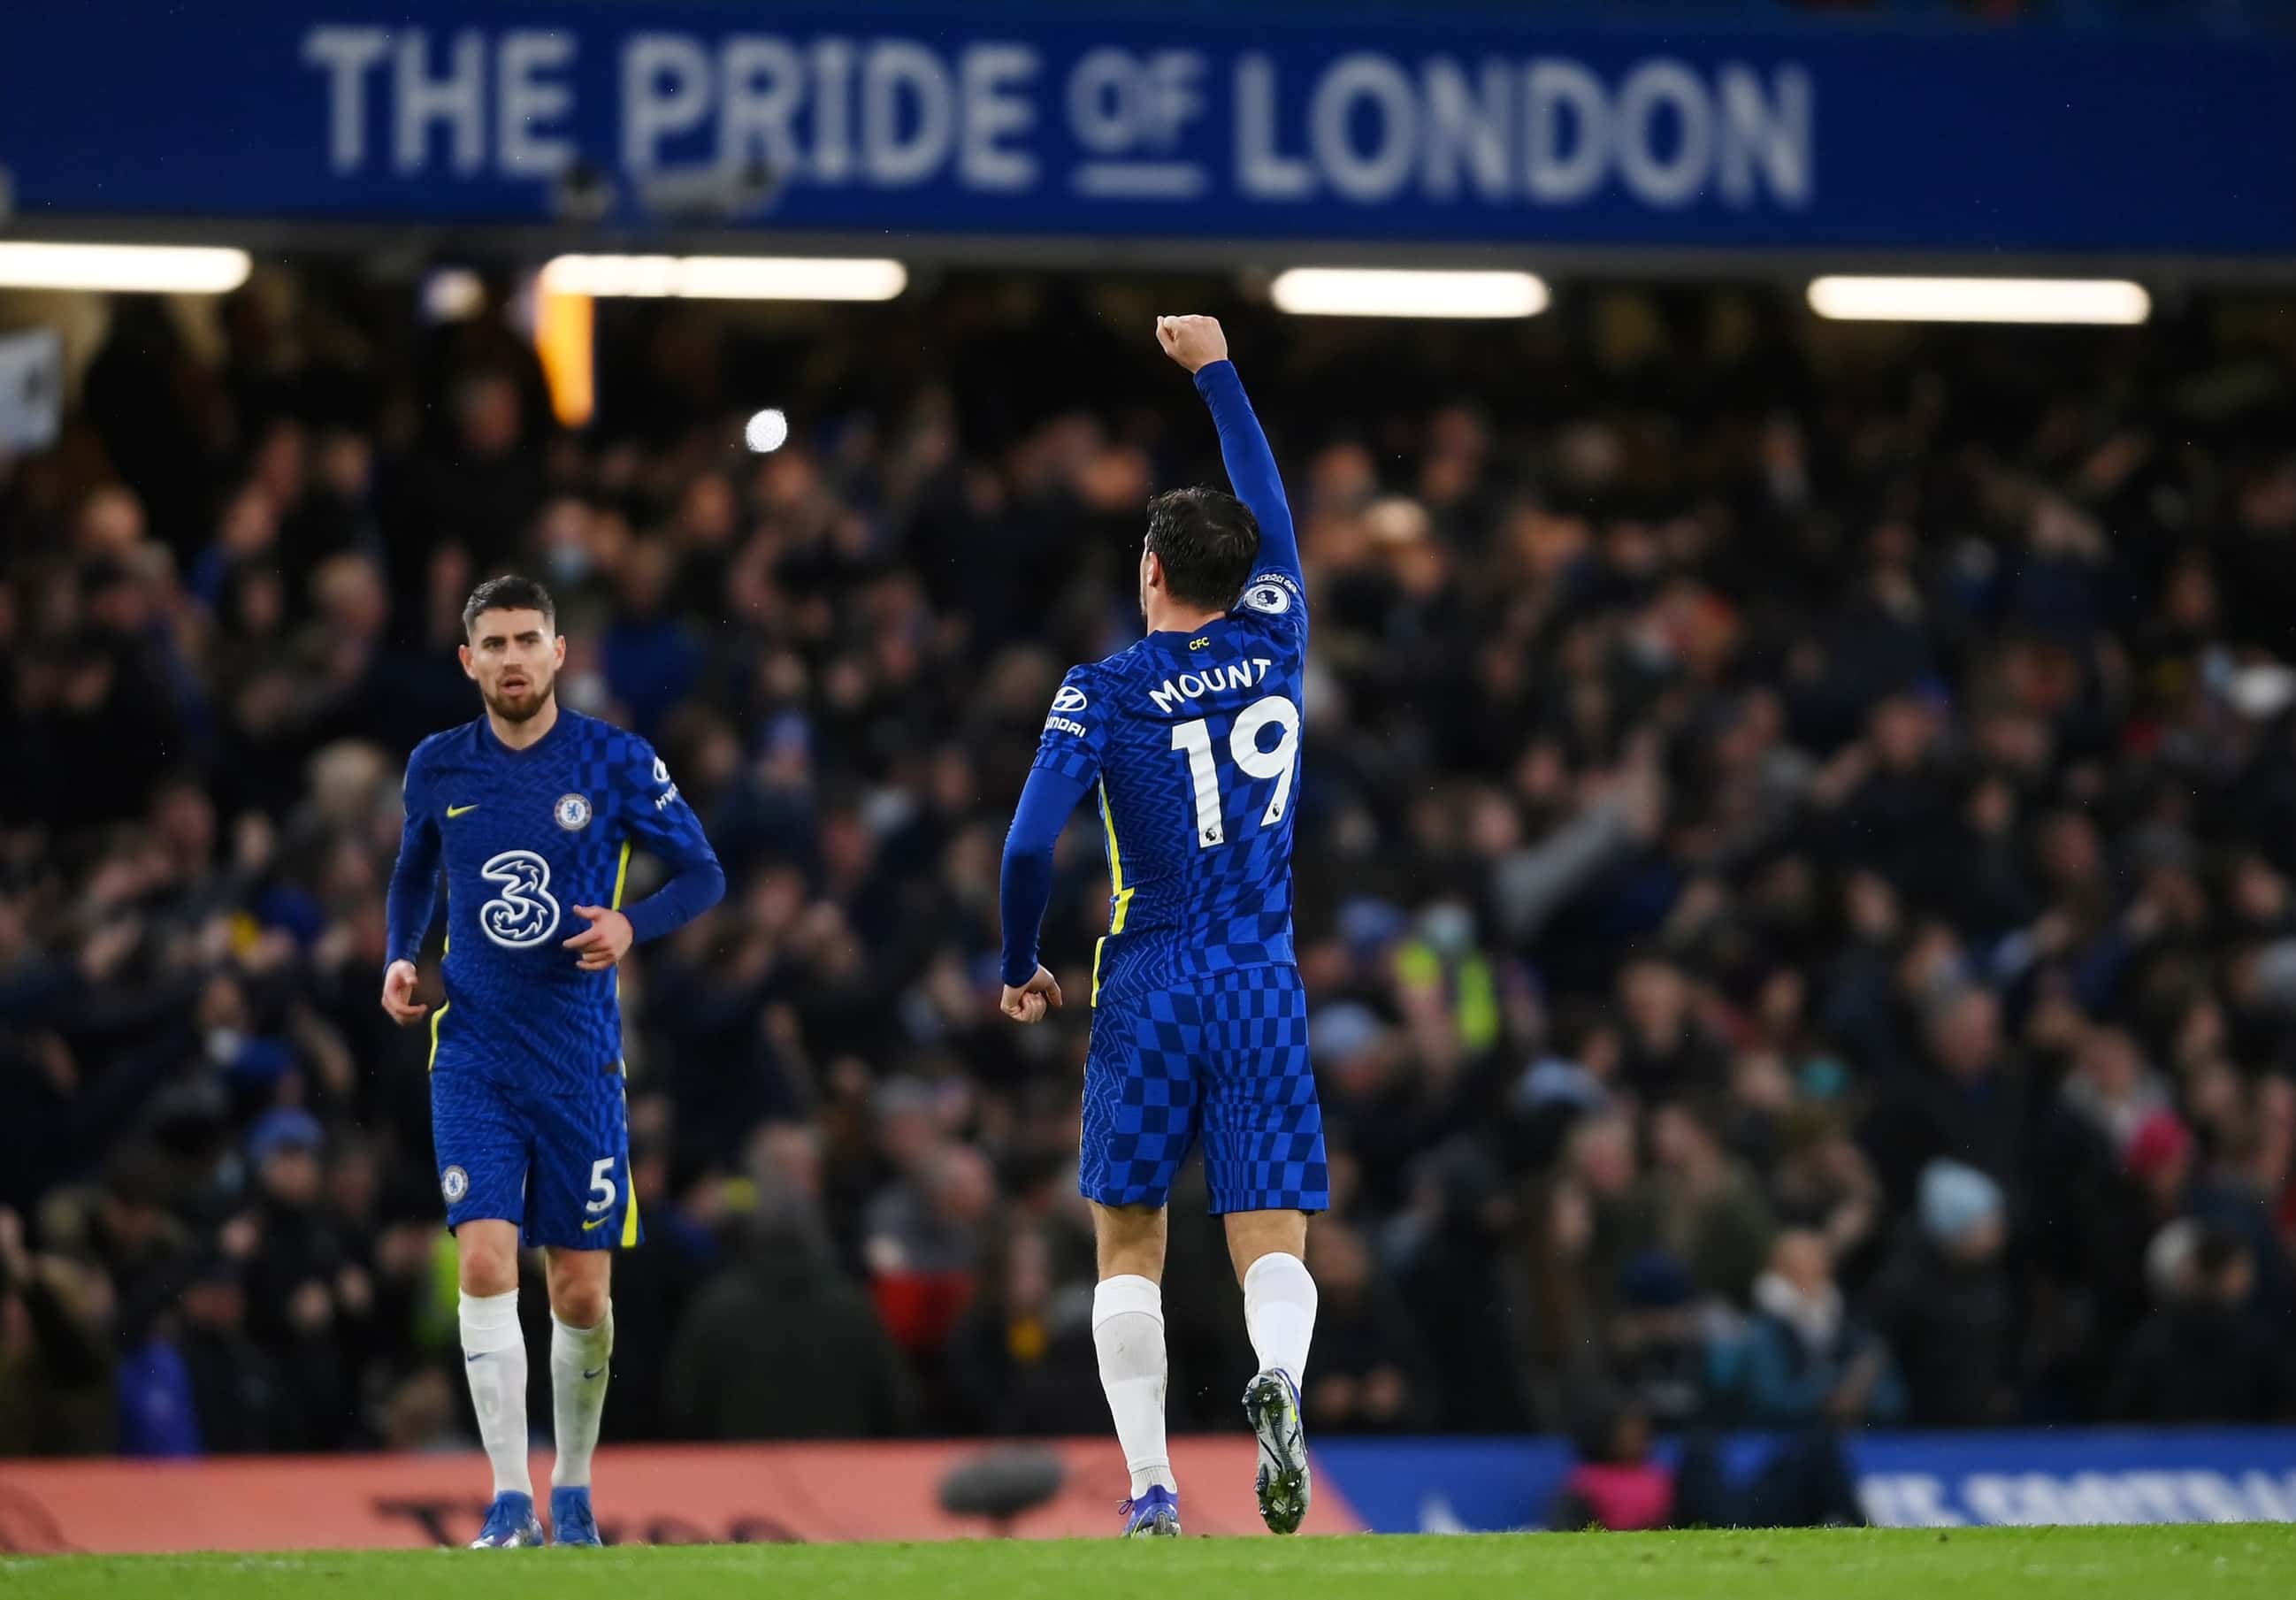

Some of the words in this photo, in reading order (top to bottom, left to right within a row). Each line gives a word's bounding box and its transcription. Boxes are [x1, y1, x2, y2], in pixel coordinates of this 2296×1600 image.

[305, 27, 577, 175] THE
[621, 34, 1041, 189] PRIDE
[1071, 50, 1207, 152] OF
[1236, 53, 1814, 209] LONDON
[1190, 637, 1210, 650] CFC
[1149, 658, 1272, 714] MOUNT
[1170, 695, 1300, 848] 19
[480, 850, 561, 948] 3
[585, 1157, 616, 1213] 5
